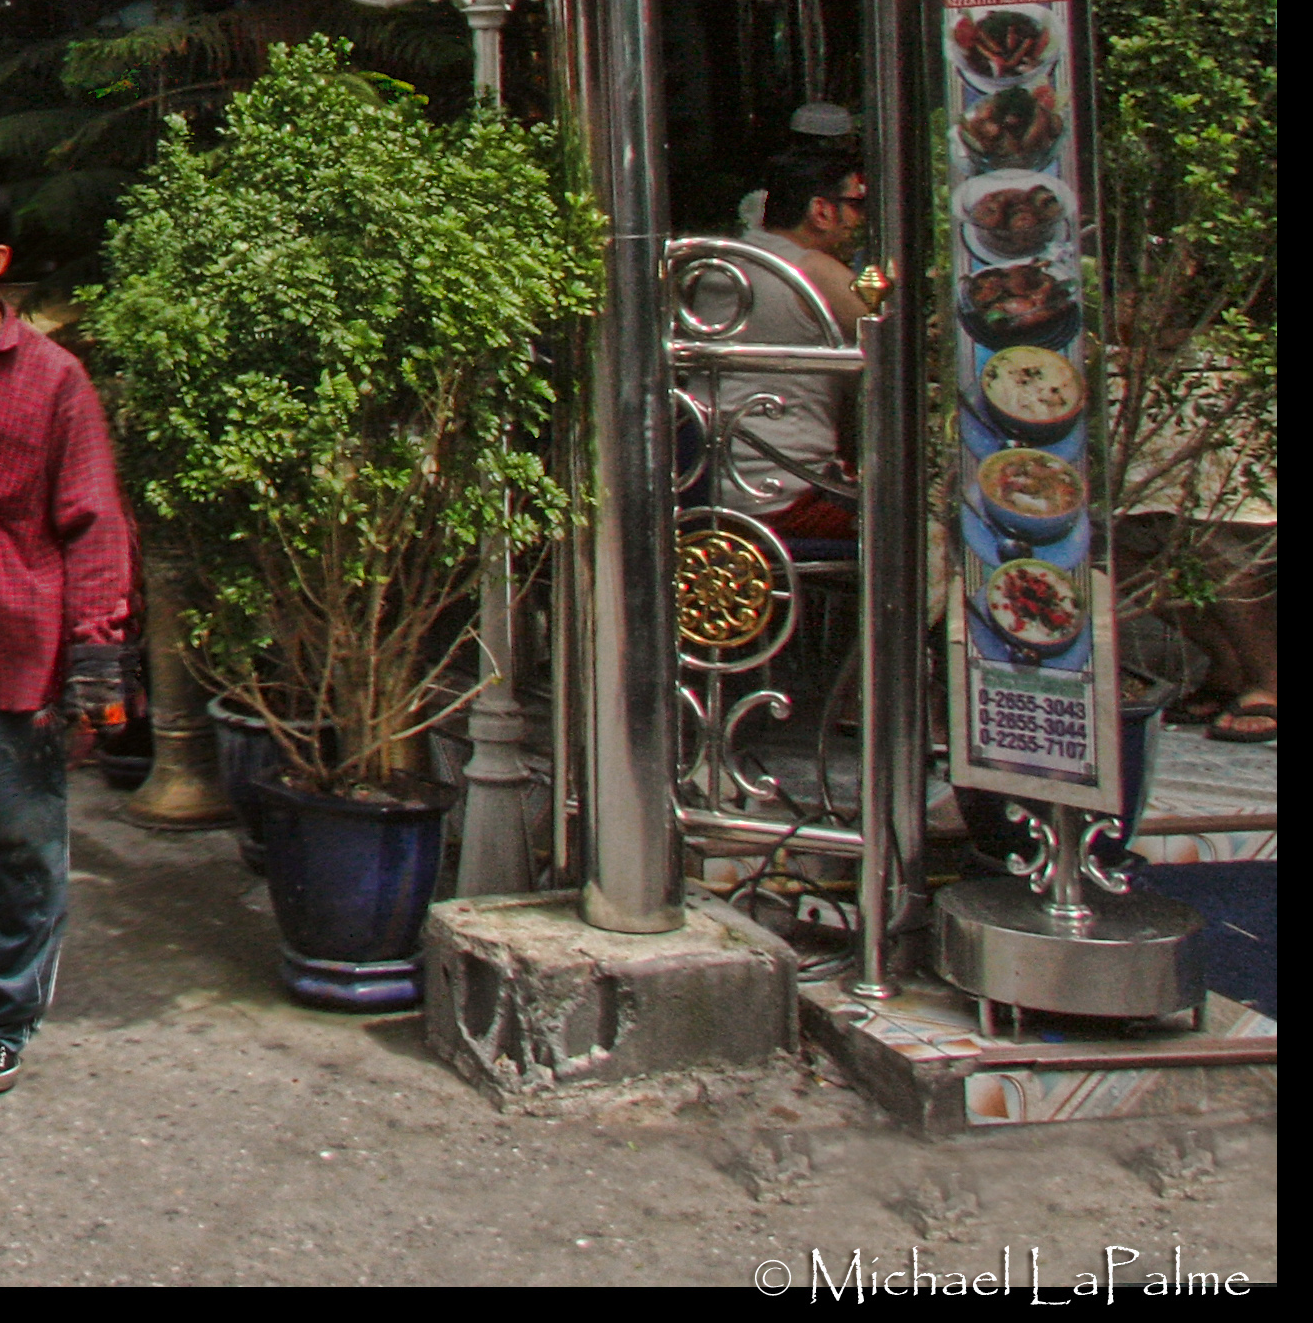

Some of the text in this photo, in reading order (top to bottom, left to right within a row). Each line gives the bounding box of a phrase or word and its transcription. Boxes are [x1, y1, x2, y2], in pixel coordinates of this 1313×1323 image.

[978, 687, 1086, 721] 0-2655-3043
[979, 707, 1087, 740] 0-2655-3044
[979, 726, 1087, 760] 0-2255-7107
